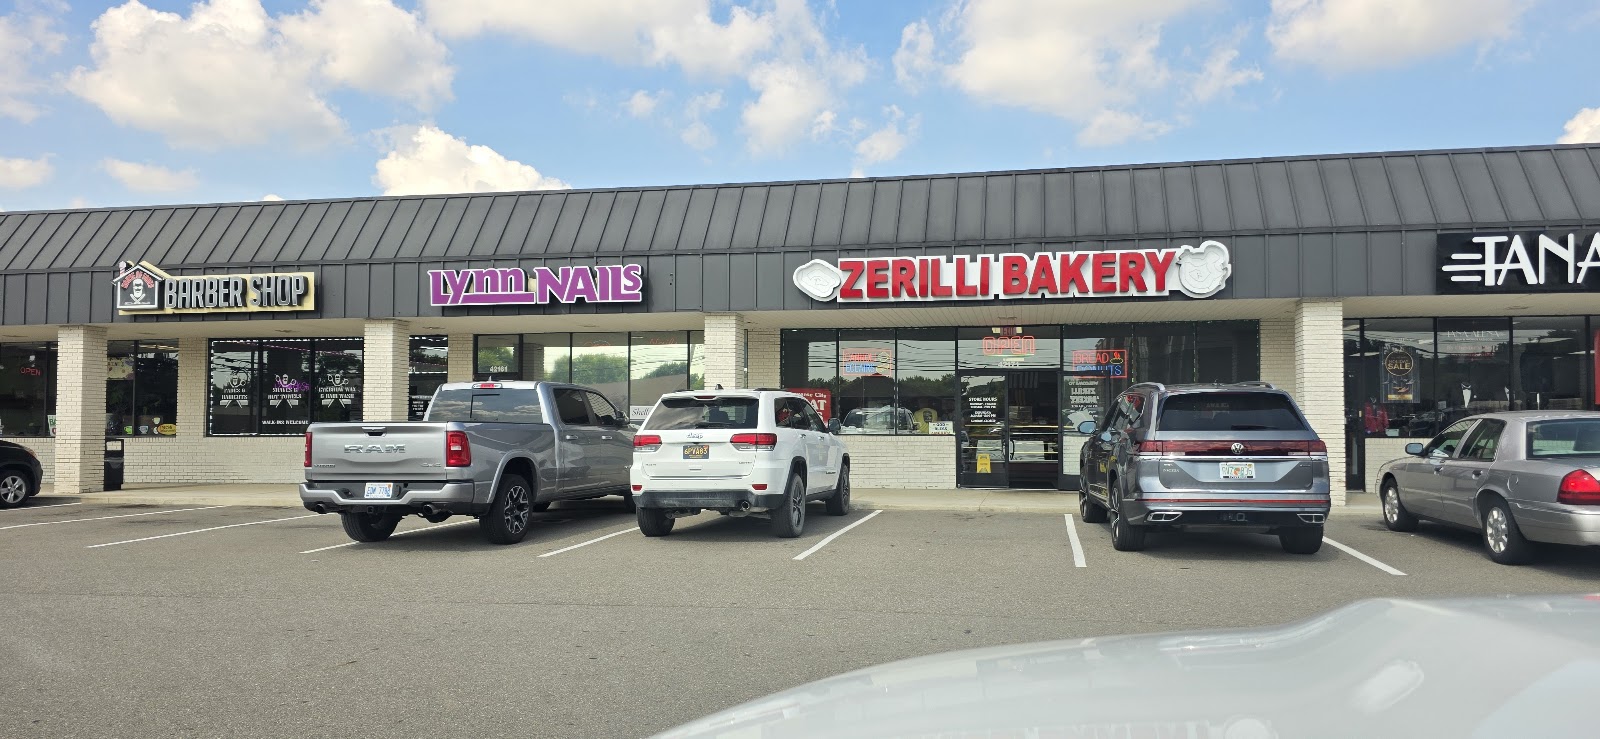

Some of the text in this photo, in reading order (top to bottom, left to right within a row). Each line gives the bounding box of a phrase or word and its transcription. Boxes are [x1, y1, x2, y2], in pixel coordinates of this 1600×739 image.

[533, 263, 643, 304] NAILS
[839, 251, 1177, 298] ZERILLI BAKERY
[164, 277, 245, 309] BARBER
[249, 275, 306, 307] SHOP
[982, 336, 1035, 355] OPEN
[1074, 352, 1110, 364] BREAD
[20, 367, 41, 376] OPEN
[344, 443, 406, 454] RAM
